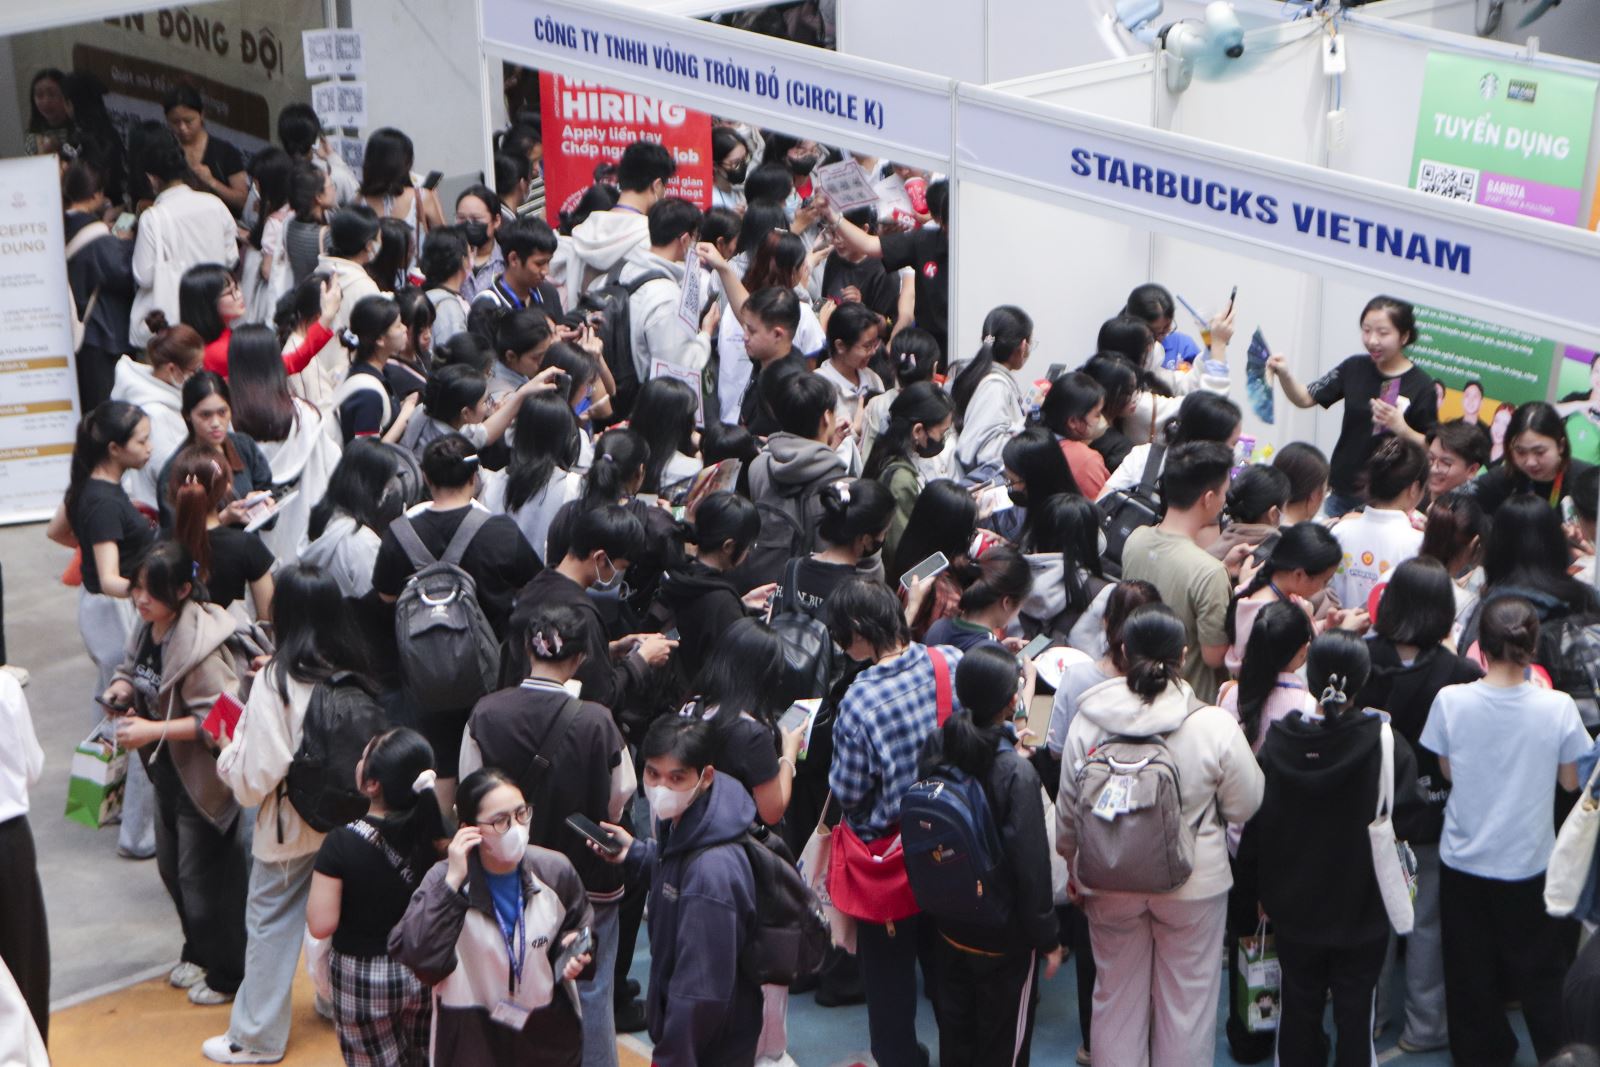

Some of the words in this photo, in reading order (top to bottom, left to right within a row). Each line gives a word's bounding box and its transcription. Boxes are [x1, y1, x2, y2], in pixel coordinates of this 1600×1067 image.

[157, 6, 230, 56] ĐỒNG
[240, 26, 284, 81] ĐỘI
[534, 15, 577, 49] CÔNG
[581, 28, 599, 54] TY
[604, 33, 648, 66] TNHH
[652, 41, 699, 79] VÒNG
[703, 56, 750, 93] TRÒN
[755, 65, 779, 100] ĐỎ
[786, 79, 858, 121] (CIRCLE
[864, 98, 884, 130] K)
[562, 90, 687, 128] HIRING
[561, 124, 606, 142] Apply
[561, 141, 599, 158] Chớp
[673, 147, 699, 165] job
[1433, 112, 1501, 147] TUYỂN
[1504, 126, 1571, 160] DỤNG
[681, 174, 703, 188] gian
[1070, 147, 1279, 225] STARBUCKS
[1292, 202, 1471, 275] VIETNAM
